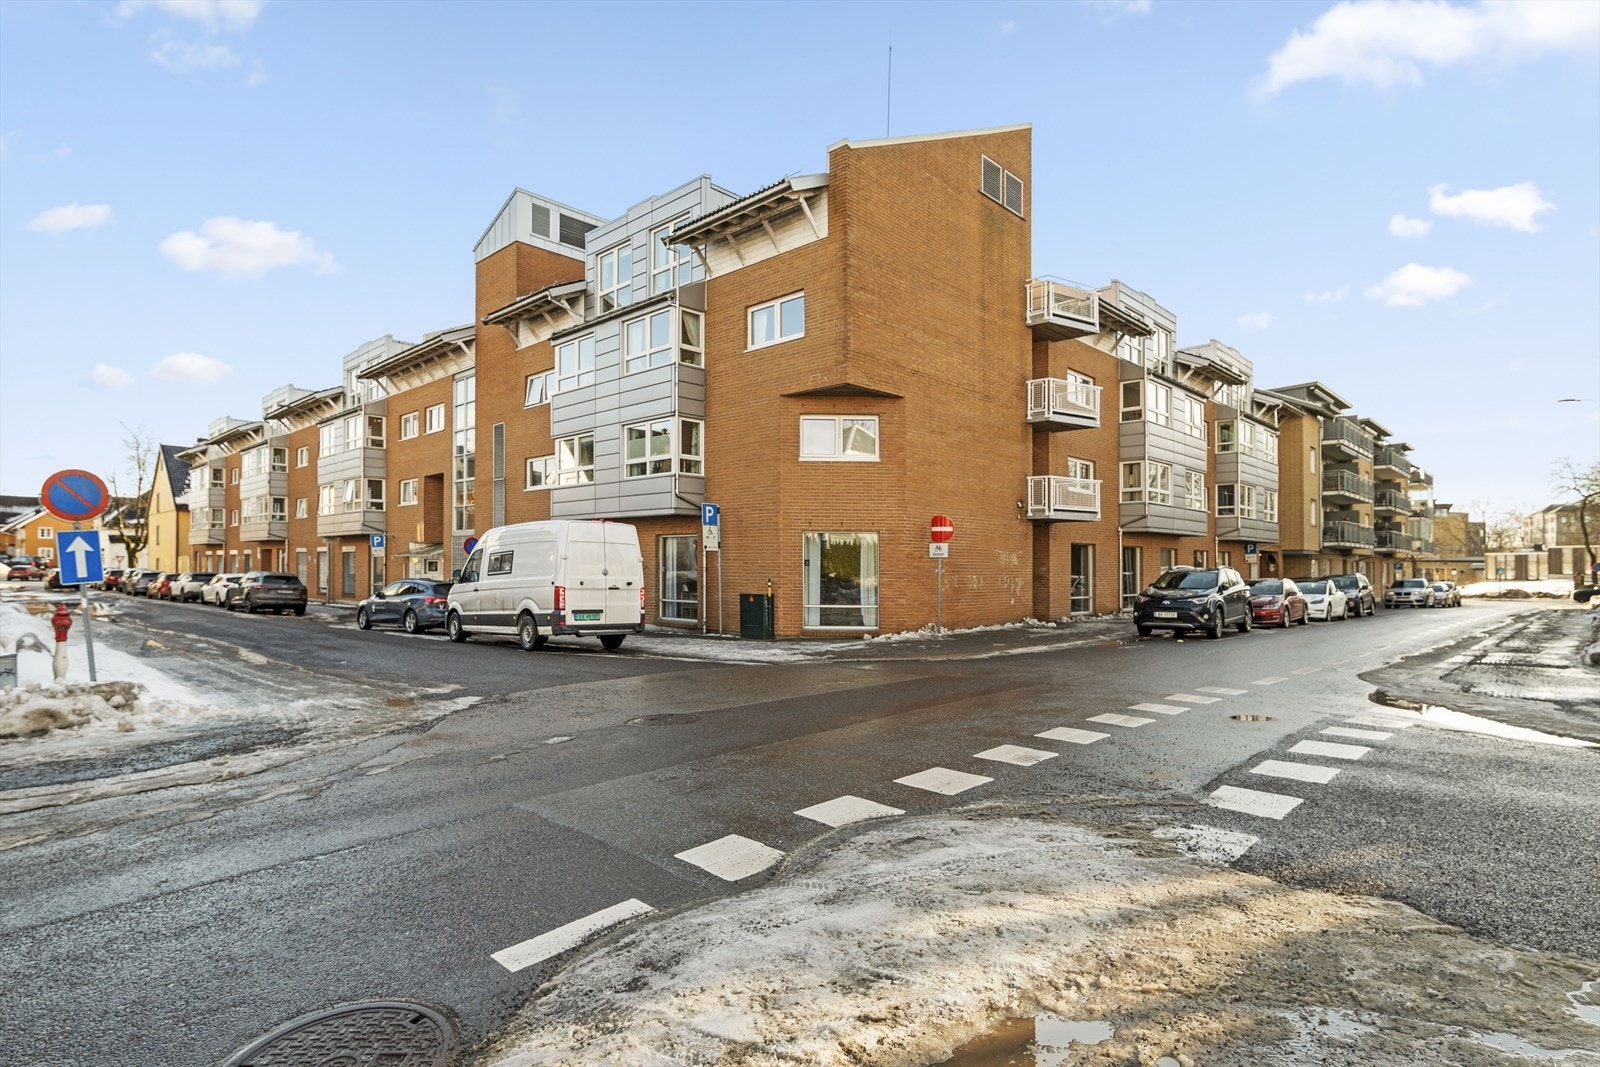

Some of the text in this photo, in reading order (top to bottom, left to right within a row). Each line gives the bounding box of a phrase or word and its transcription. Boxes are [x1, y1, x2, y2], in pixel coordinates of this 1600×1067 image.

[706, 506, 714, 523] P
[373, 536, 382, 546] P
[1247, 544, 1254, 553] P
